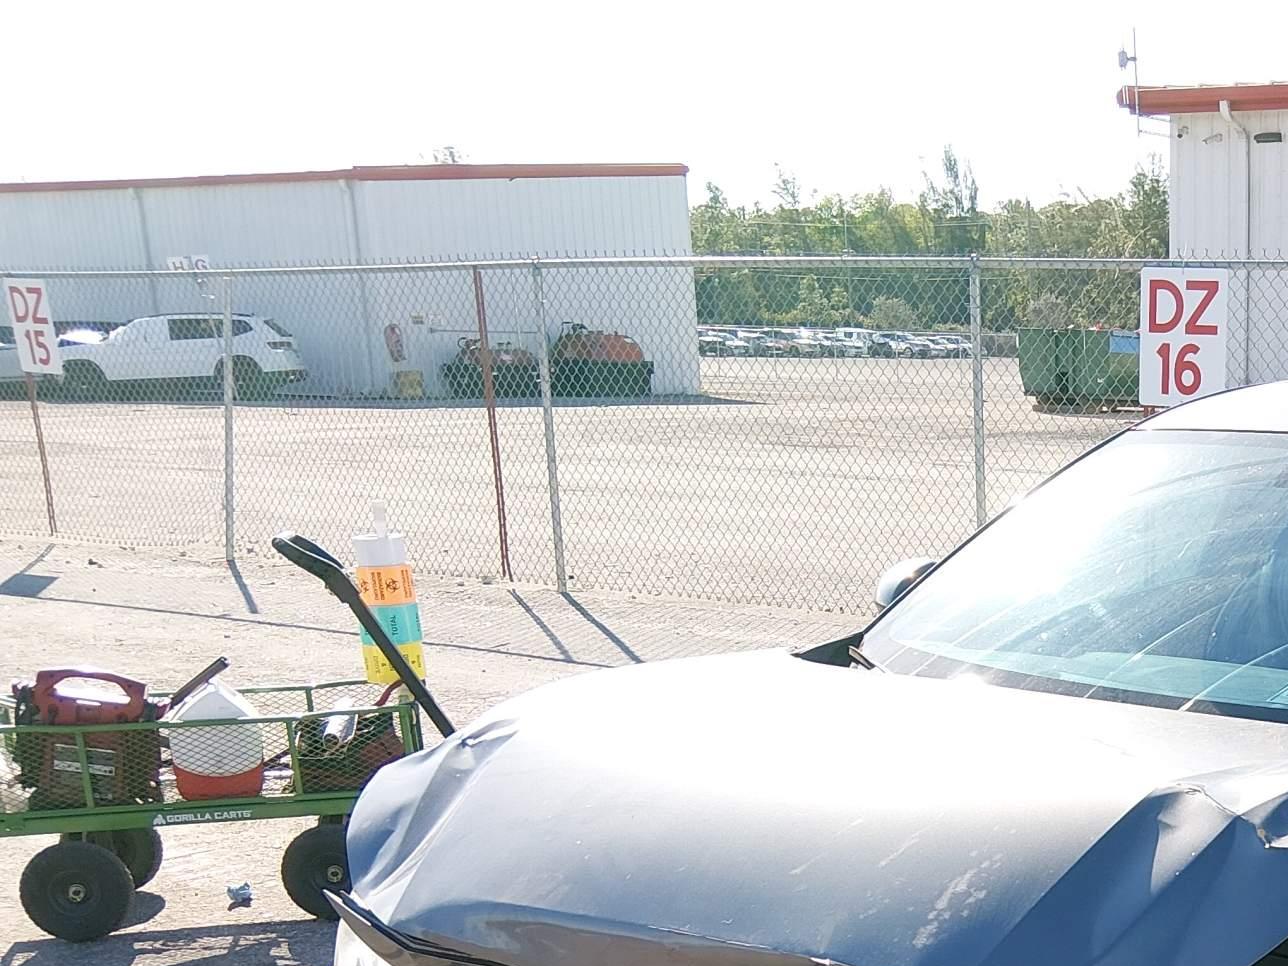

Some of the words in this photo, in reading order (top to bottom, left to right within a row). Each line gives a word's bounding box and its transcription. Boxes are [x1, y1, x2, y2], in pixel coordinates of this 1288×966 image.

[8, 286, 49, 325] DZ
[1148, 279, 1219, 335] DZ
[25, 330, 51, 366] 15
[1156, 342, 1201, 396] 16
[166, 812, 212, 823] GORILLA
[214, 810, 252, 820] CARTS
